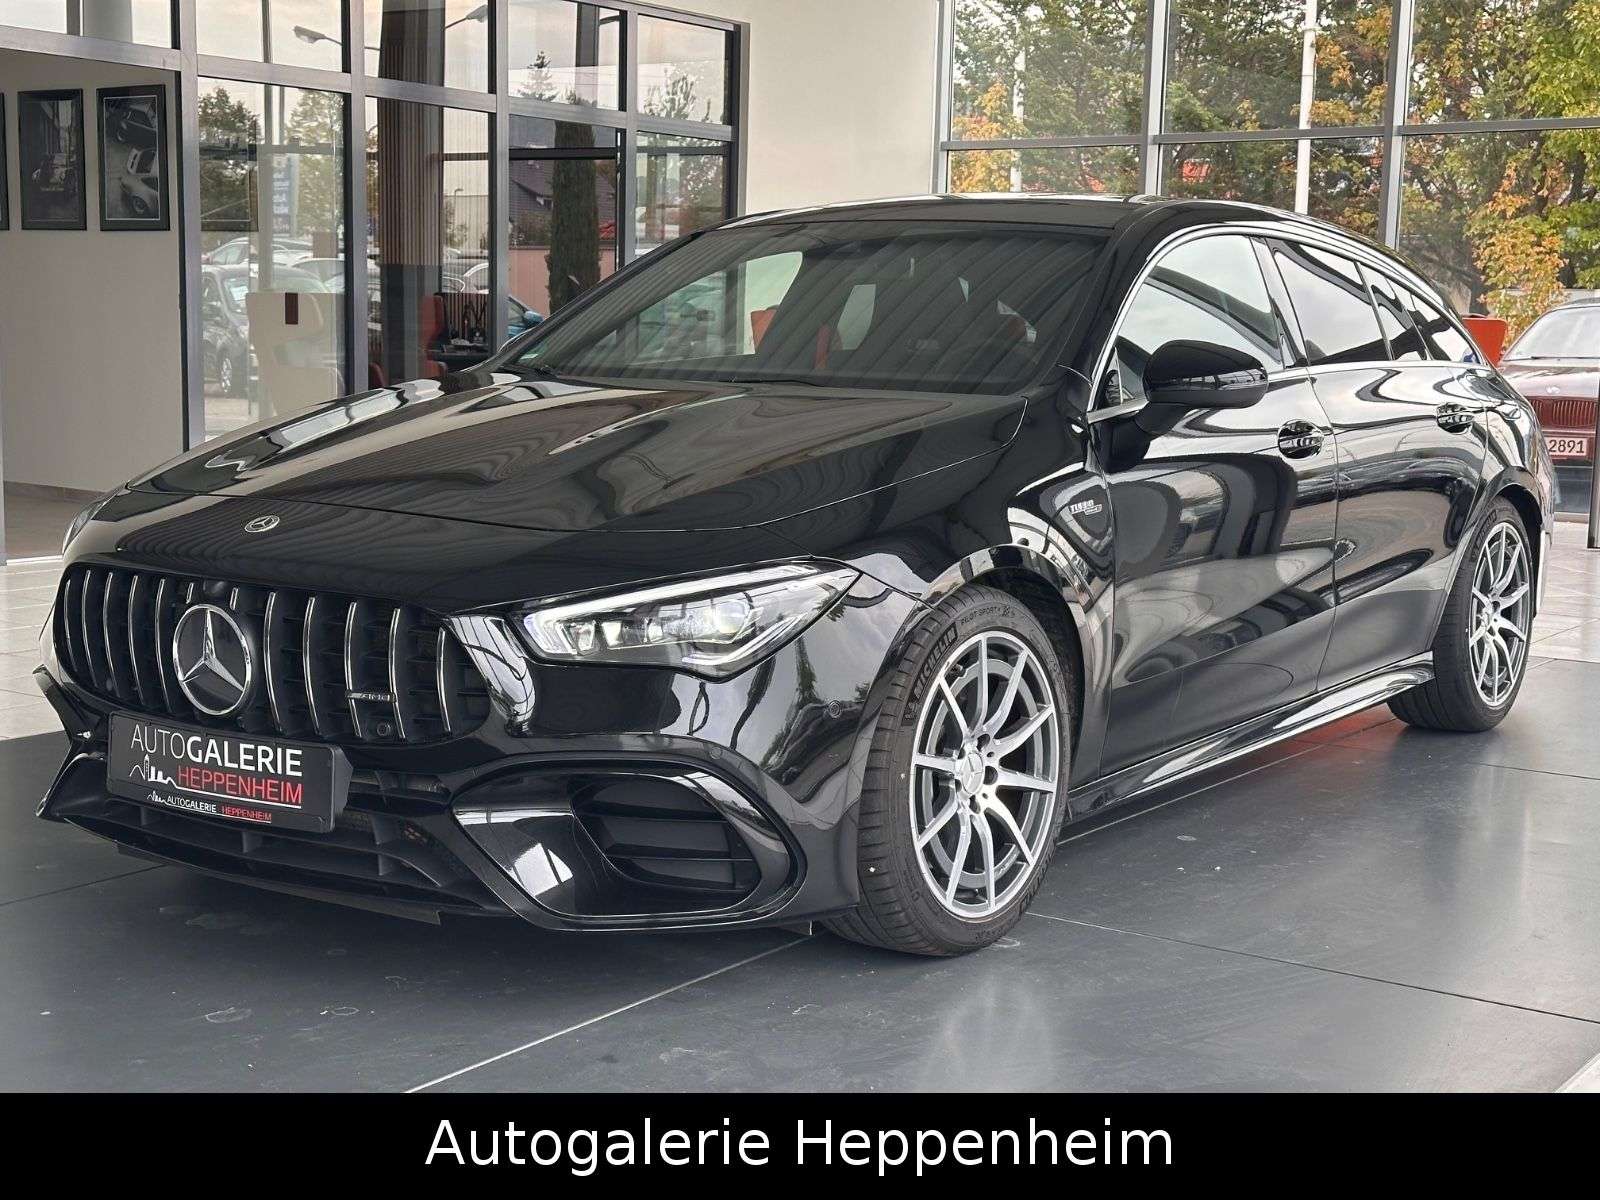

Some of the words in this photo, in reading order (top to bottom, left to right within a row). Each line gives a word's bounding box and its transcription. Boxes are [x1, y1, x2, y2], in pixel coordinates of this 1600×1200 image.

[1548, 439, 1585, 454] 2891
[912, 623, 958, 700] MICHELIN
[129, 723, 303, 778] AUTOGALERIE
[177, 764, 303, 805] HEPPENHEIM
[166, 794, 217, 814] AUTOGALERIE
[221, 805, 272, 822] HEPPENHEIM
